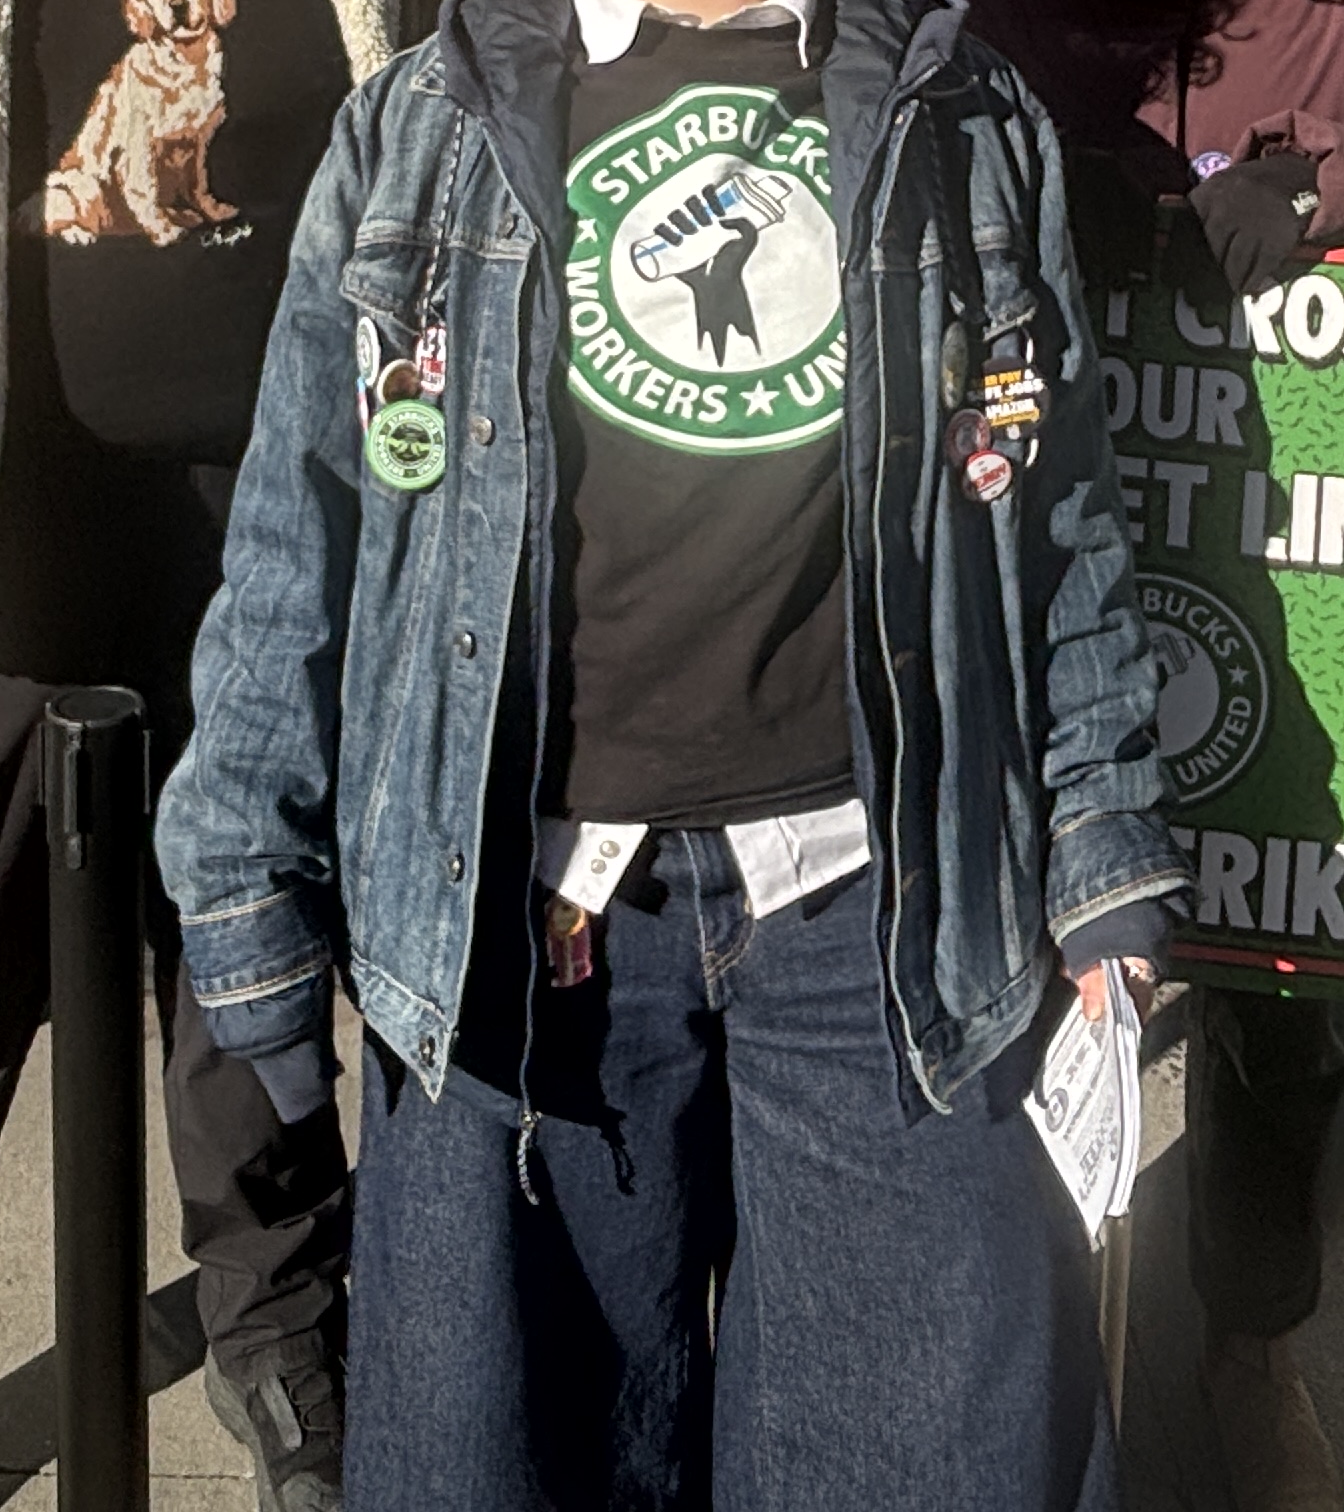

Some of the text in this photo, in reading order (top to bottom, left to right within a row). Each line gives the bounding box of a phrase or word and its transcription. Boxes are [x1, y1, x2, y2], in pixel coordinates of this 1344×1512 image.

[566, 255, 728, 423] WORKERS
[1143, 588, 1241, 659] BUCKS
[1176, 695, 1252, 785] UNITED
